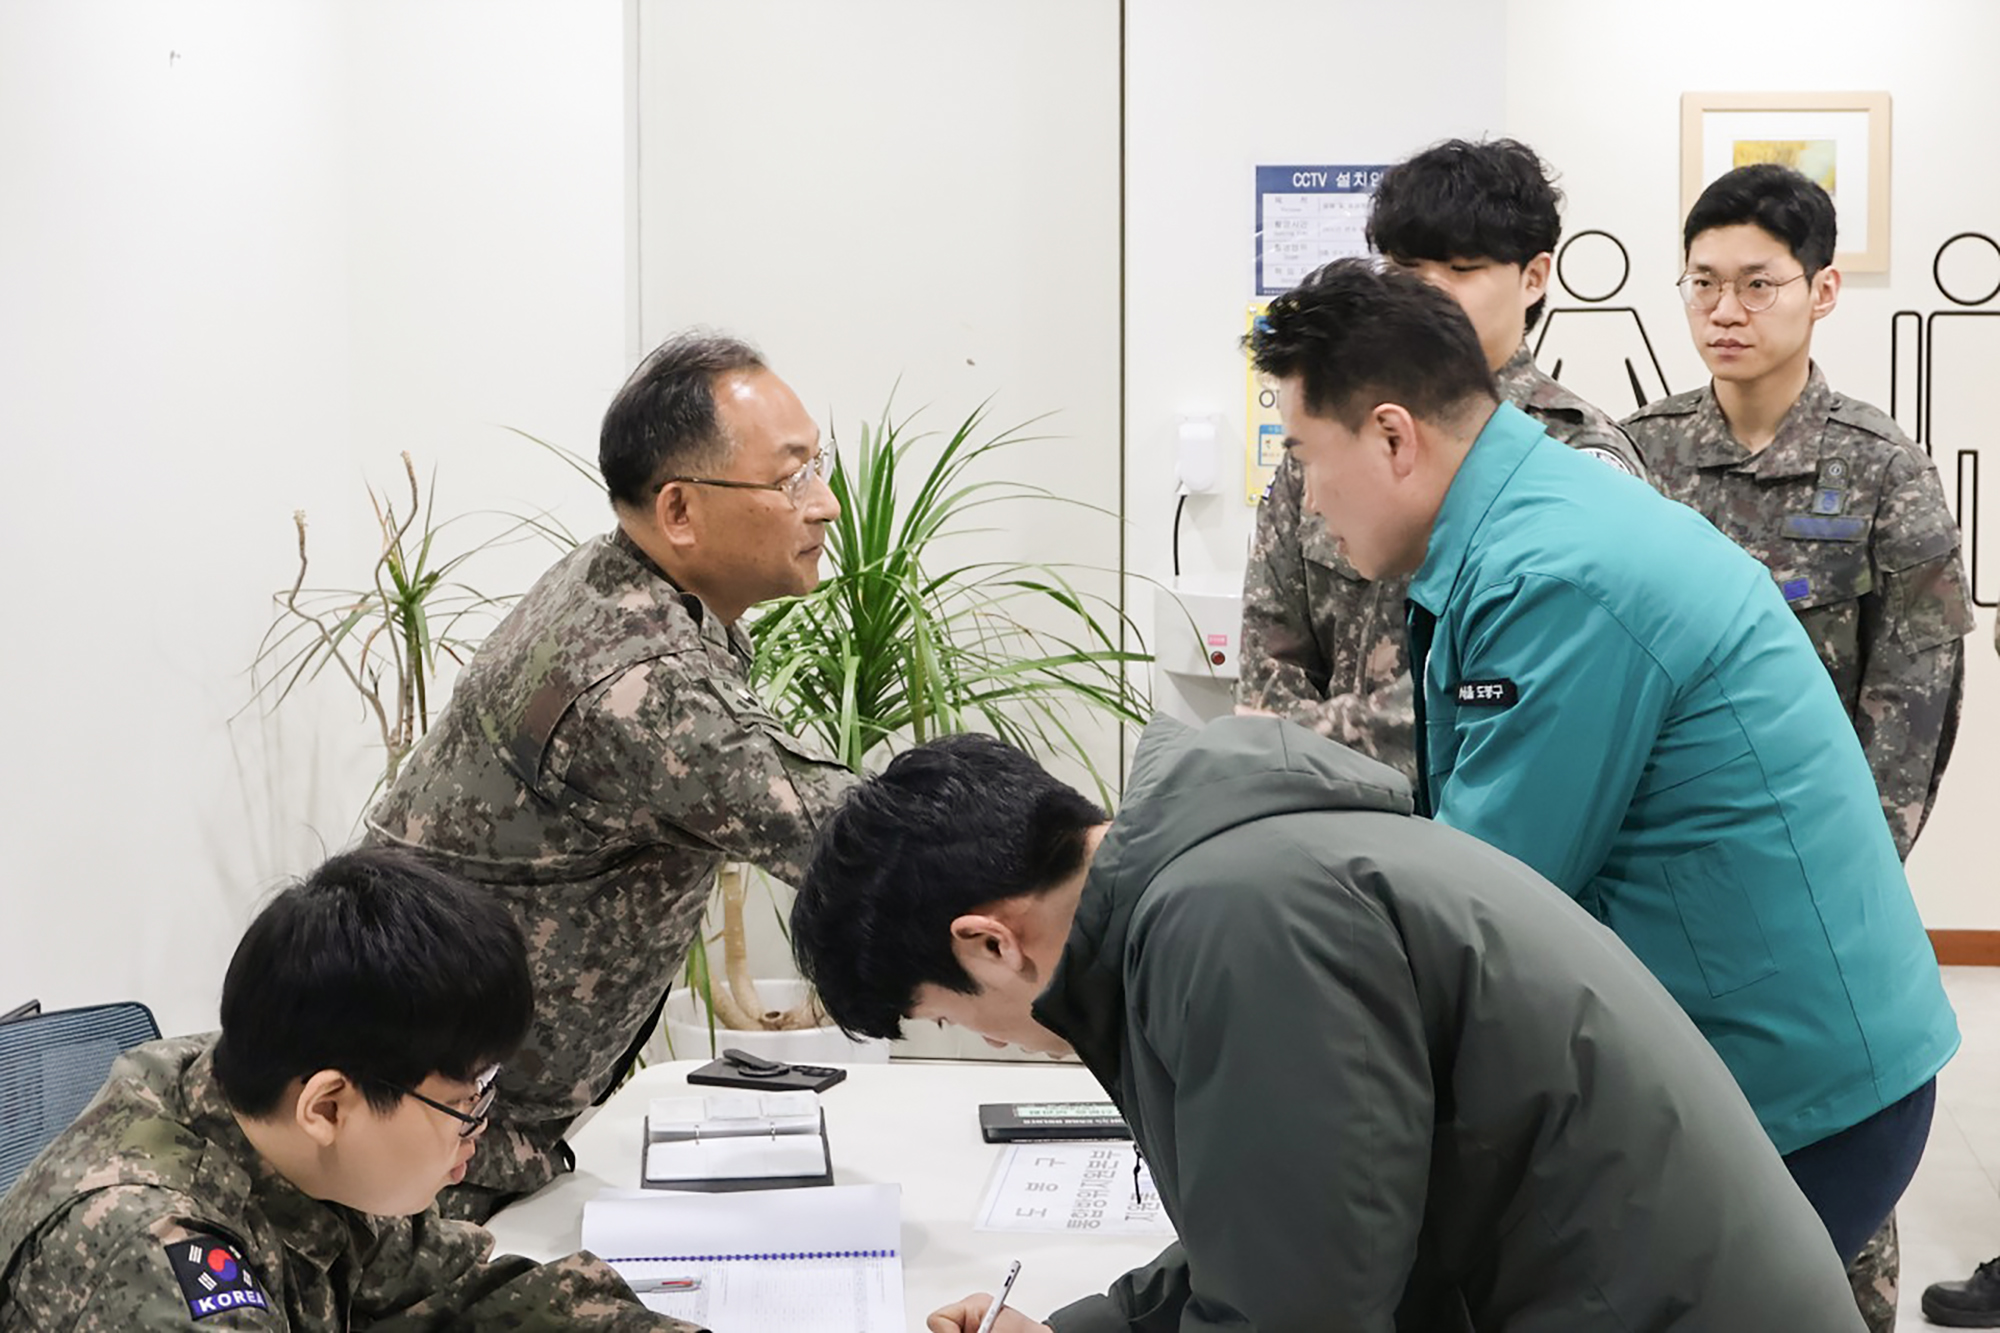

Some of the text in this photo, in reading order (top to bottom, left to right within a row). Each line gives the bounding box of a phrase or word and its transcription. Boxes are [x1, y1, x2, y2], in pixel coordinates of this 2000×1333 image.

[1292, 172, 1328, 188] CCTV
[1476, 684, 1504, 700] 도봉구
[198, 1290, 266, 1313] KOREA
